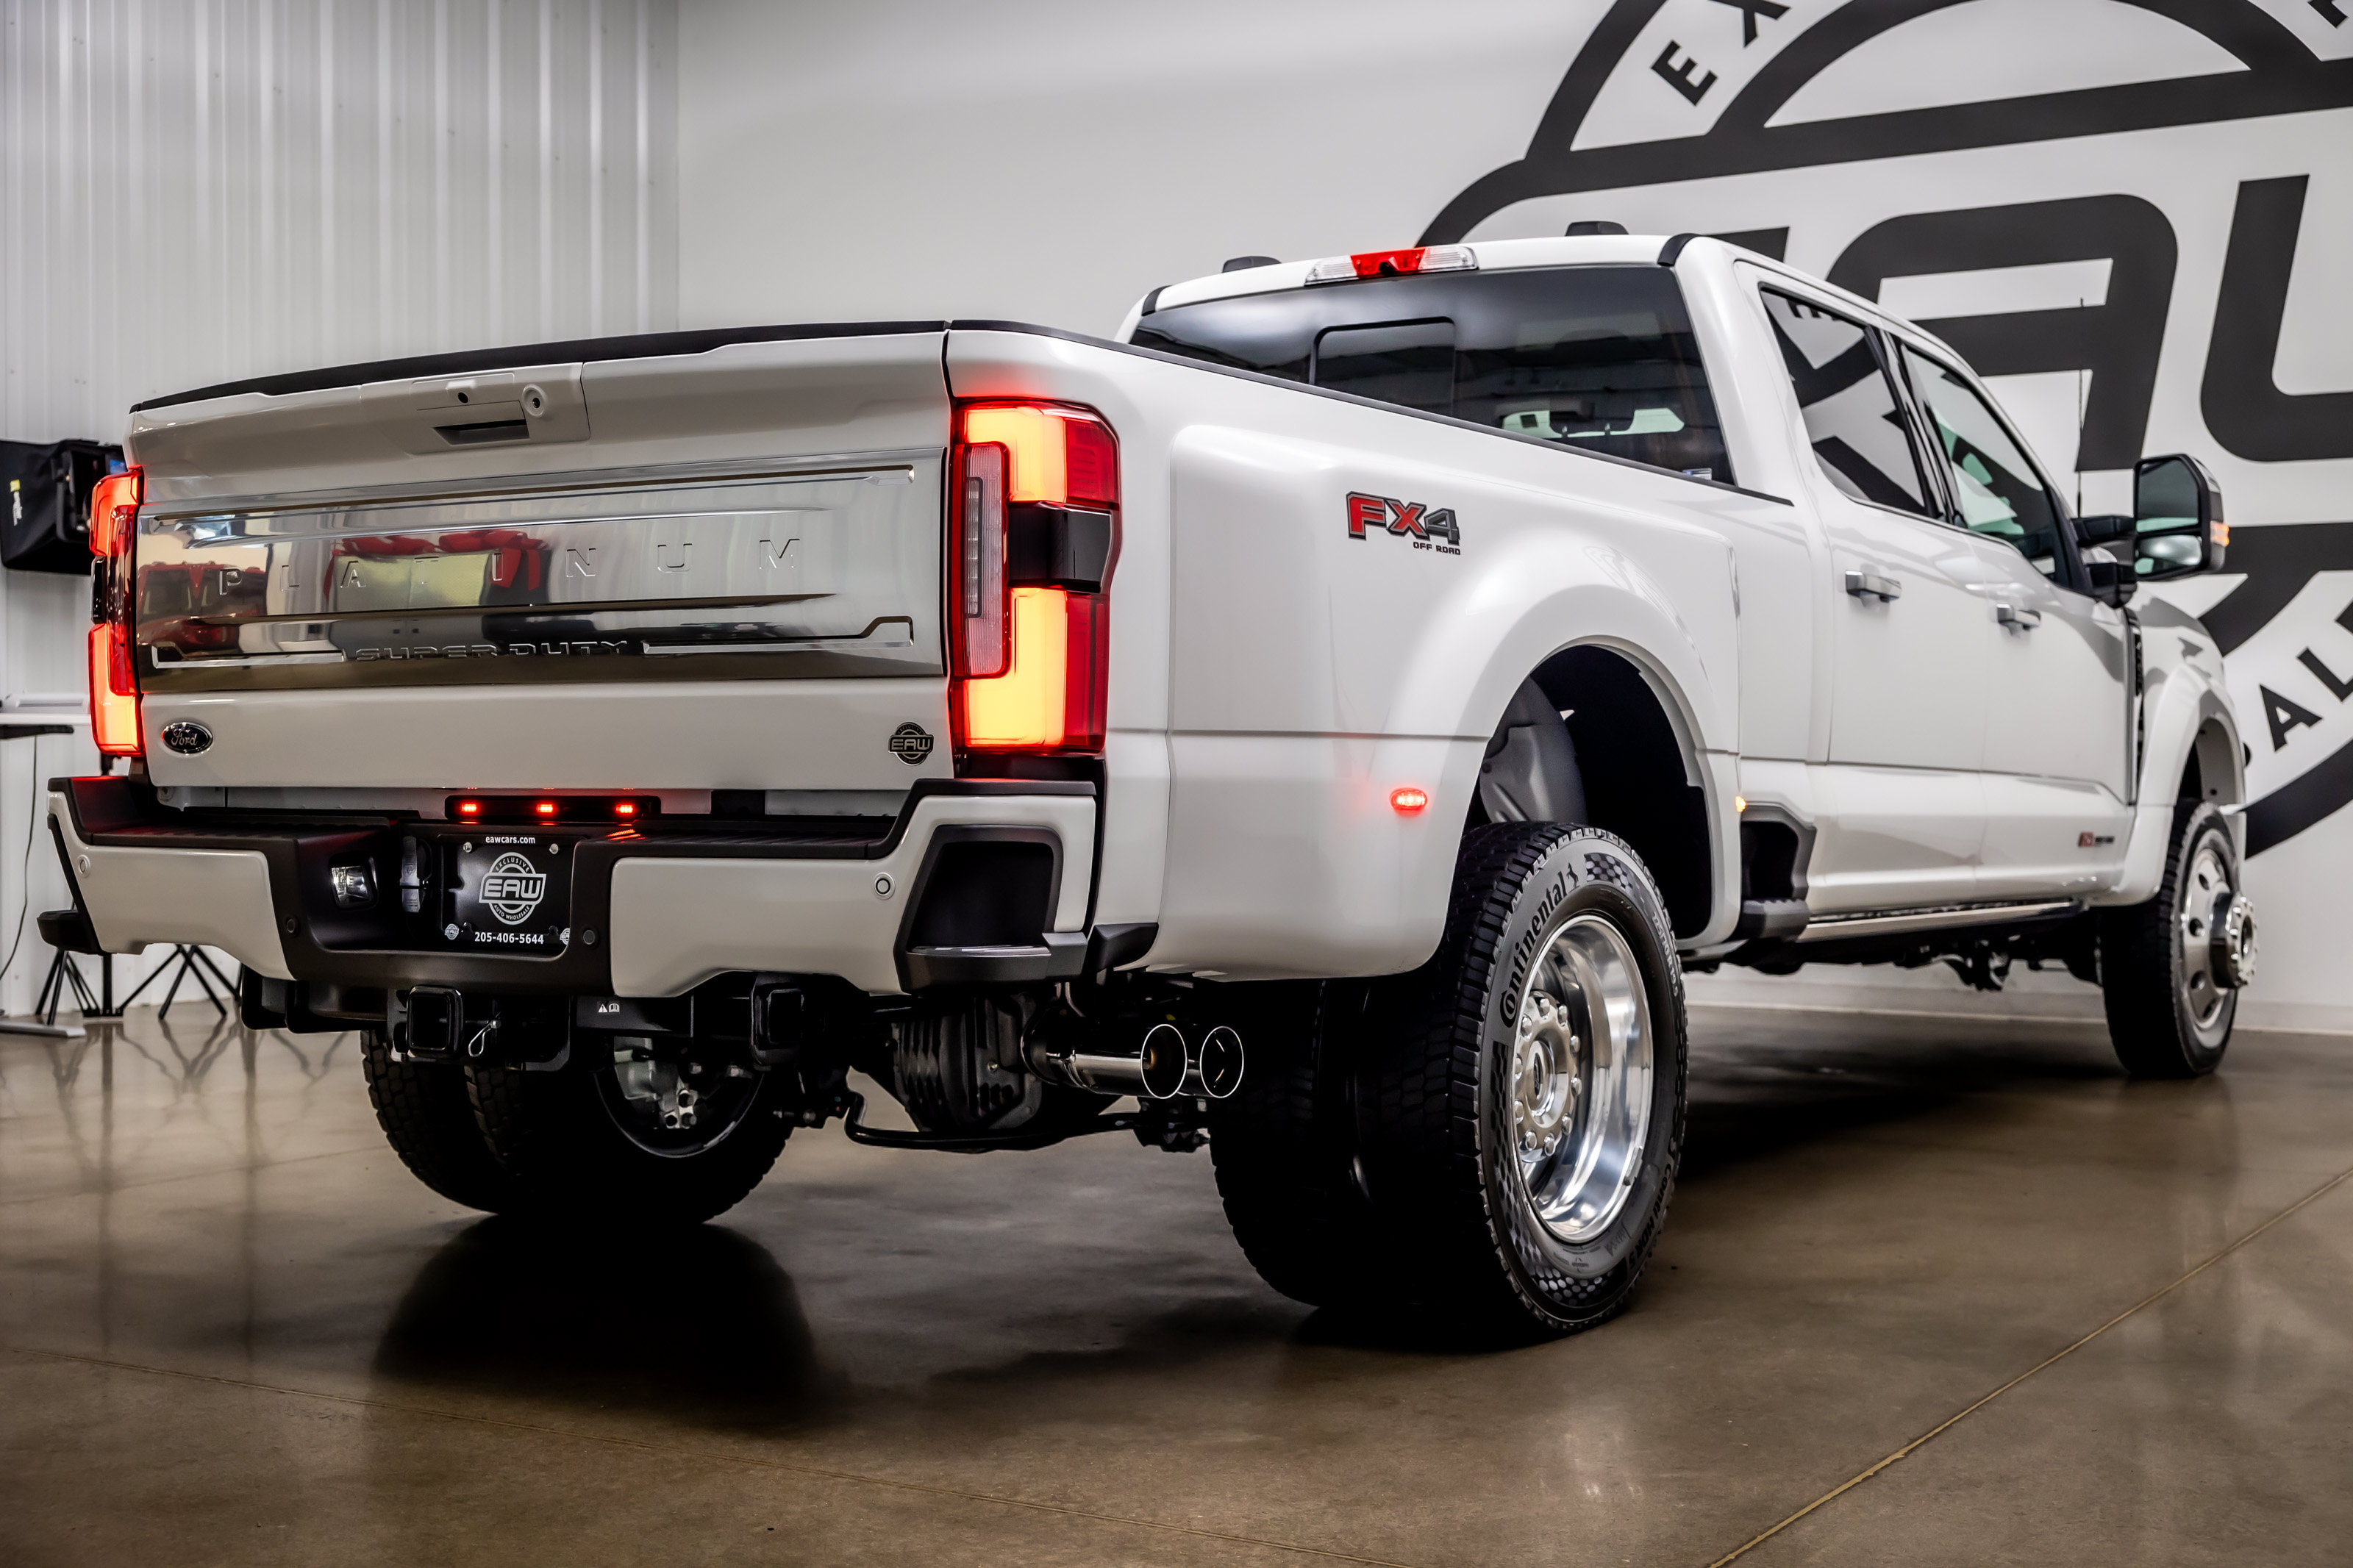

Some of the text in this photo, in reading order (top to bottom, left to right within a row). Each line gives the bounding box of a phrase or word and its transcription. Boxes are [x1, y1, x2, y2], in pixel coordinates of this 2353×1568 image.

[1346, 490, 1460, 545] FX4
[1413, 542, 1461, 555] OFF ROAD
[219, 534, 801, 596] PLATINUM
[356, 640, 628, 660] SUPER DUTY
[171, 728, 199, 746] Ford
[891, 738, 931, 751] EAW
[485, 836, 536, 844] eawcars.com
[495, 856, 530, 873] EXCLUSIVE
[484, 878, 541, 898] EAW
[493, 904, 530, 920] AUTO WHOLESALE
[474, 931, 544, 945] 205-406-5644
[1499, 871, 1568, 1028] Continental
